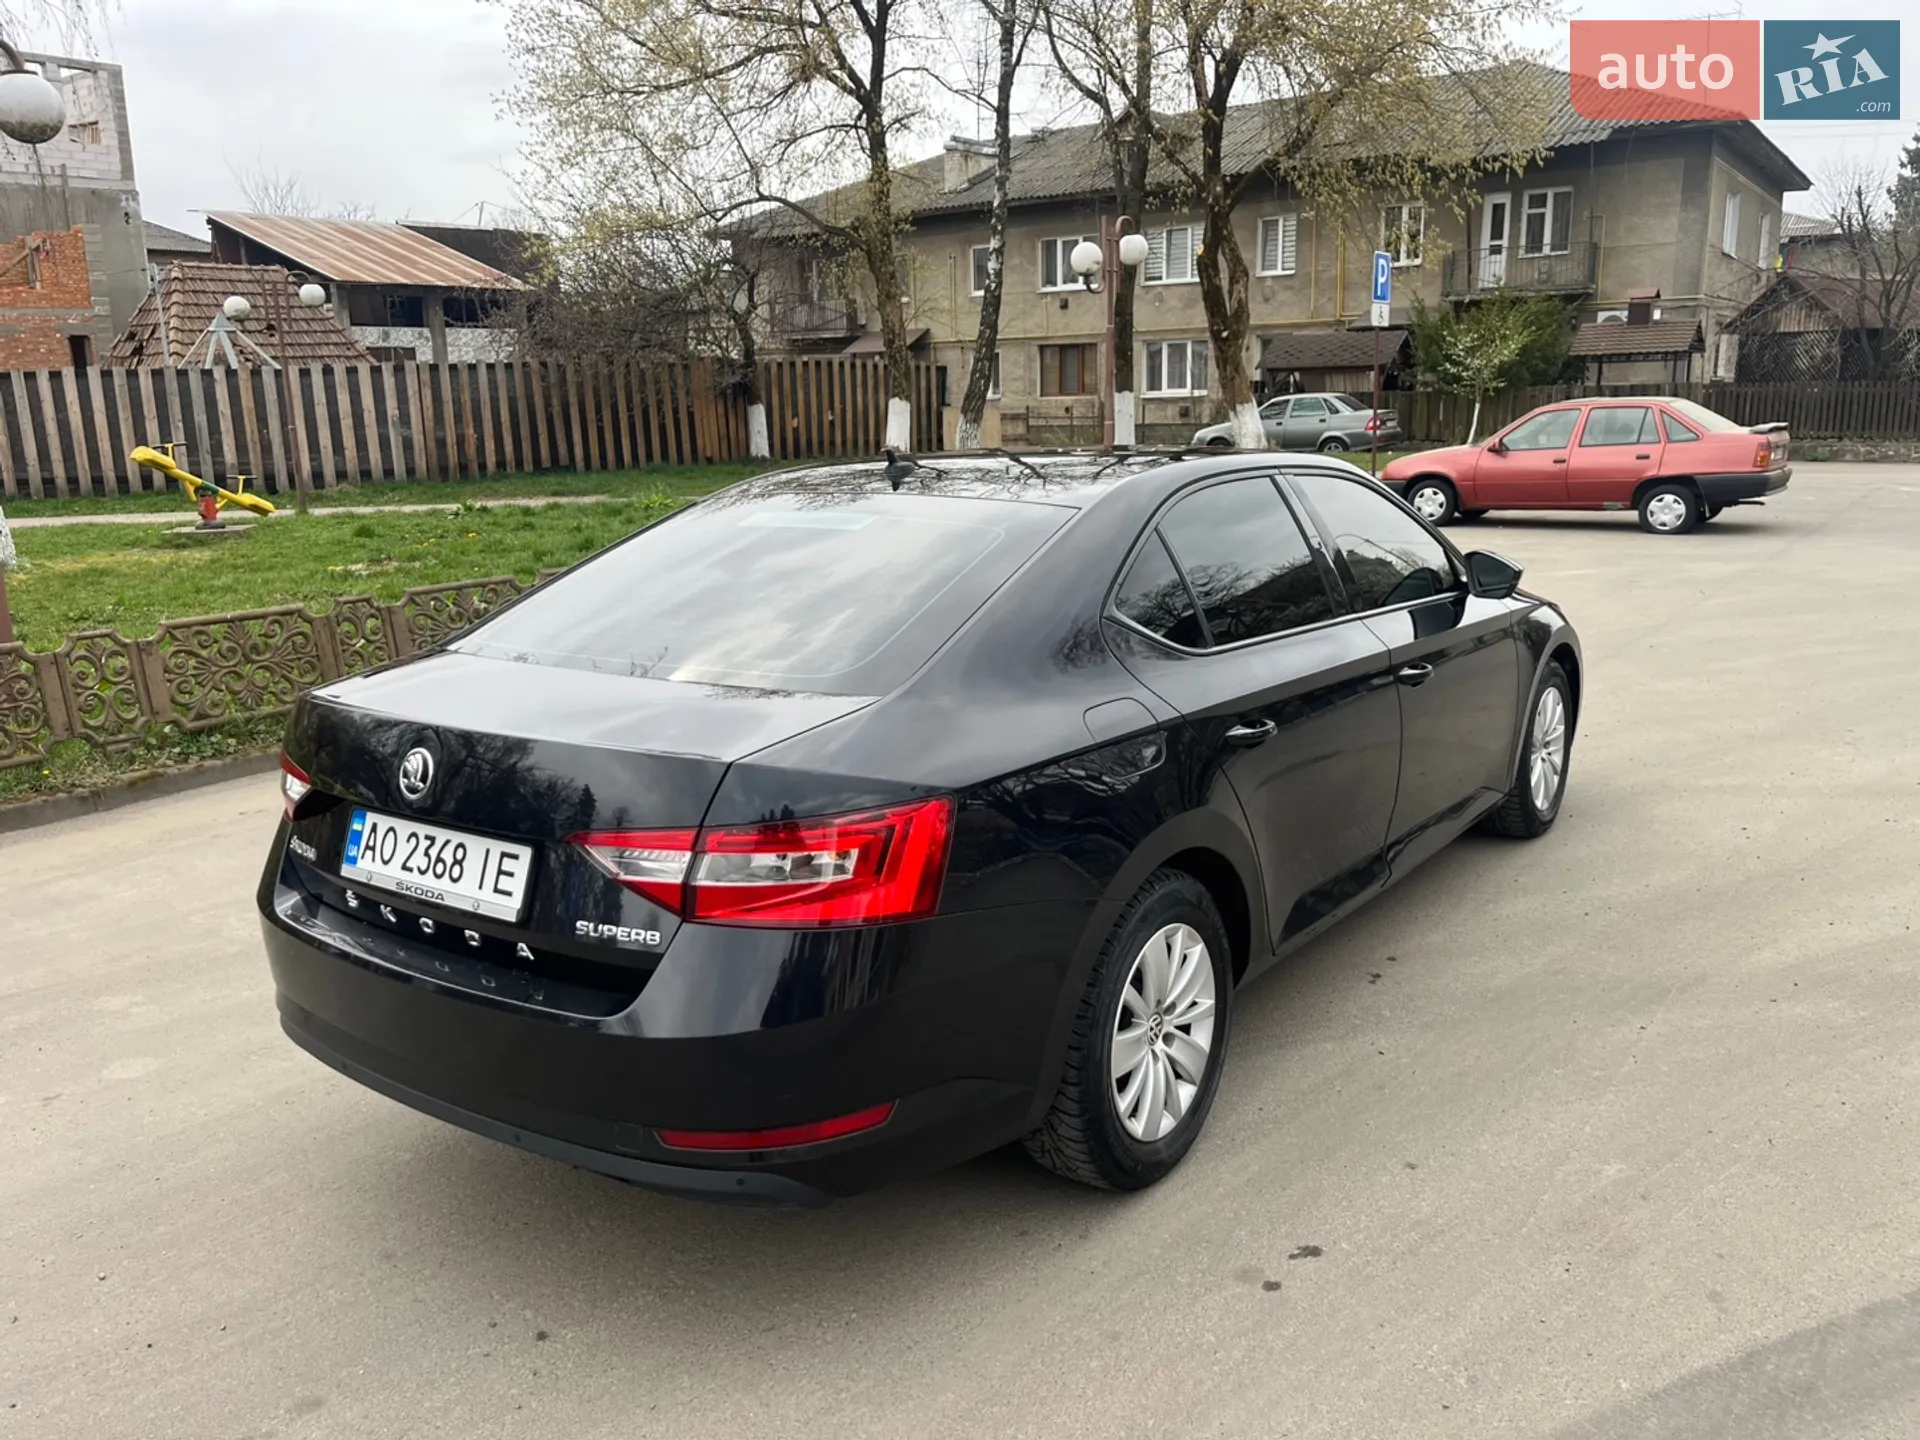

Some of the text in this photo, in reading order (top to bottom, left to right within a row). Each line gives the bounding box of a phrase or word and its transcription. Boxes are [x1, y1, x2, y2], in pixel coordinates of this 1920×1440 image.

[1377, 258, 1387, 296] P
[361, 821, 519, 897] AO 2368 IE
[575, 920, 661, 945] SUPERB
